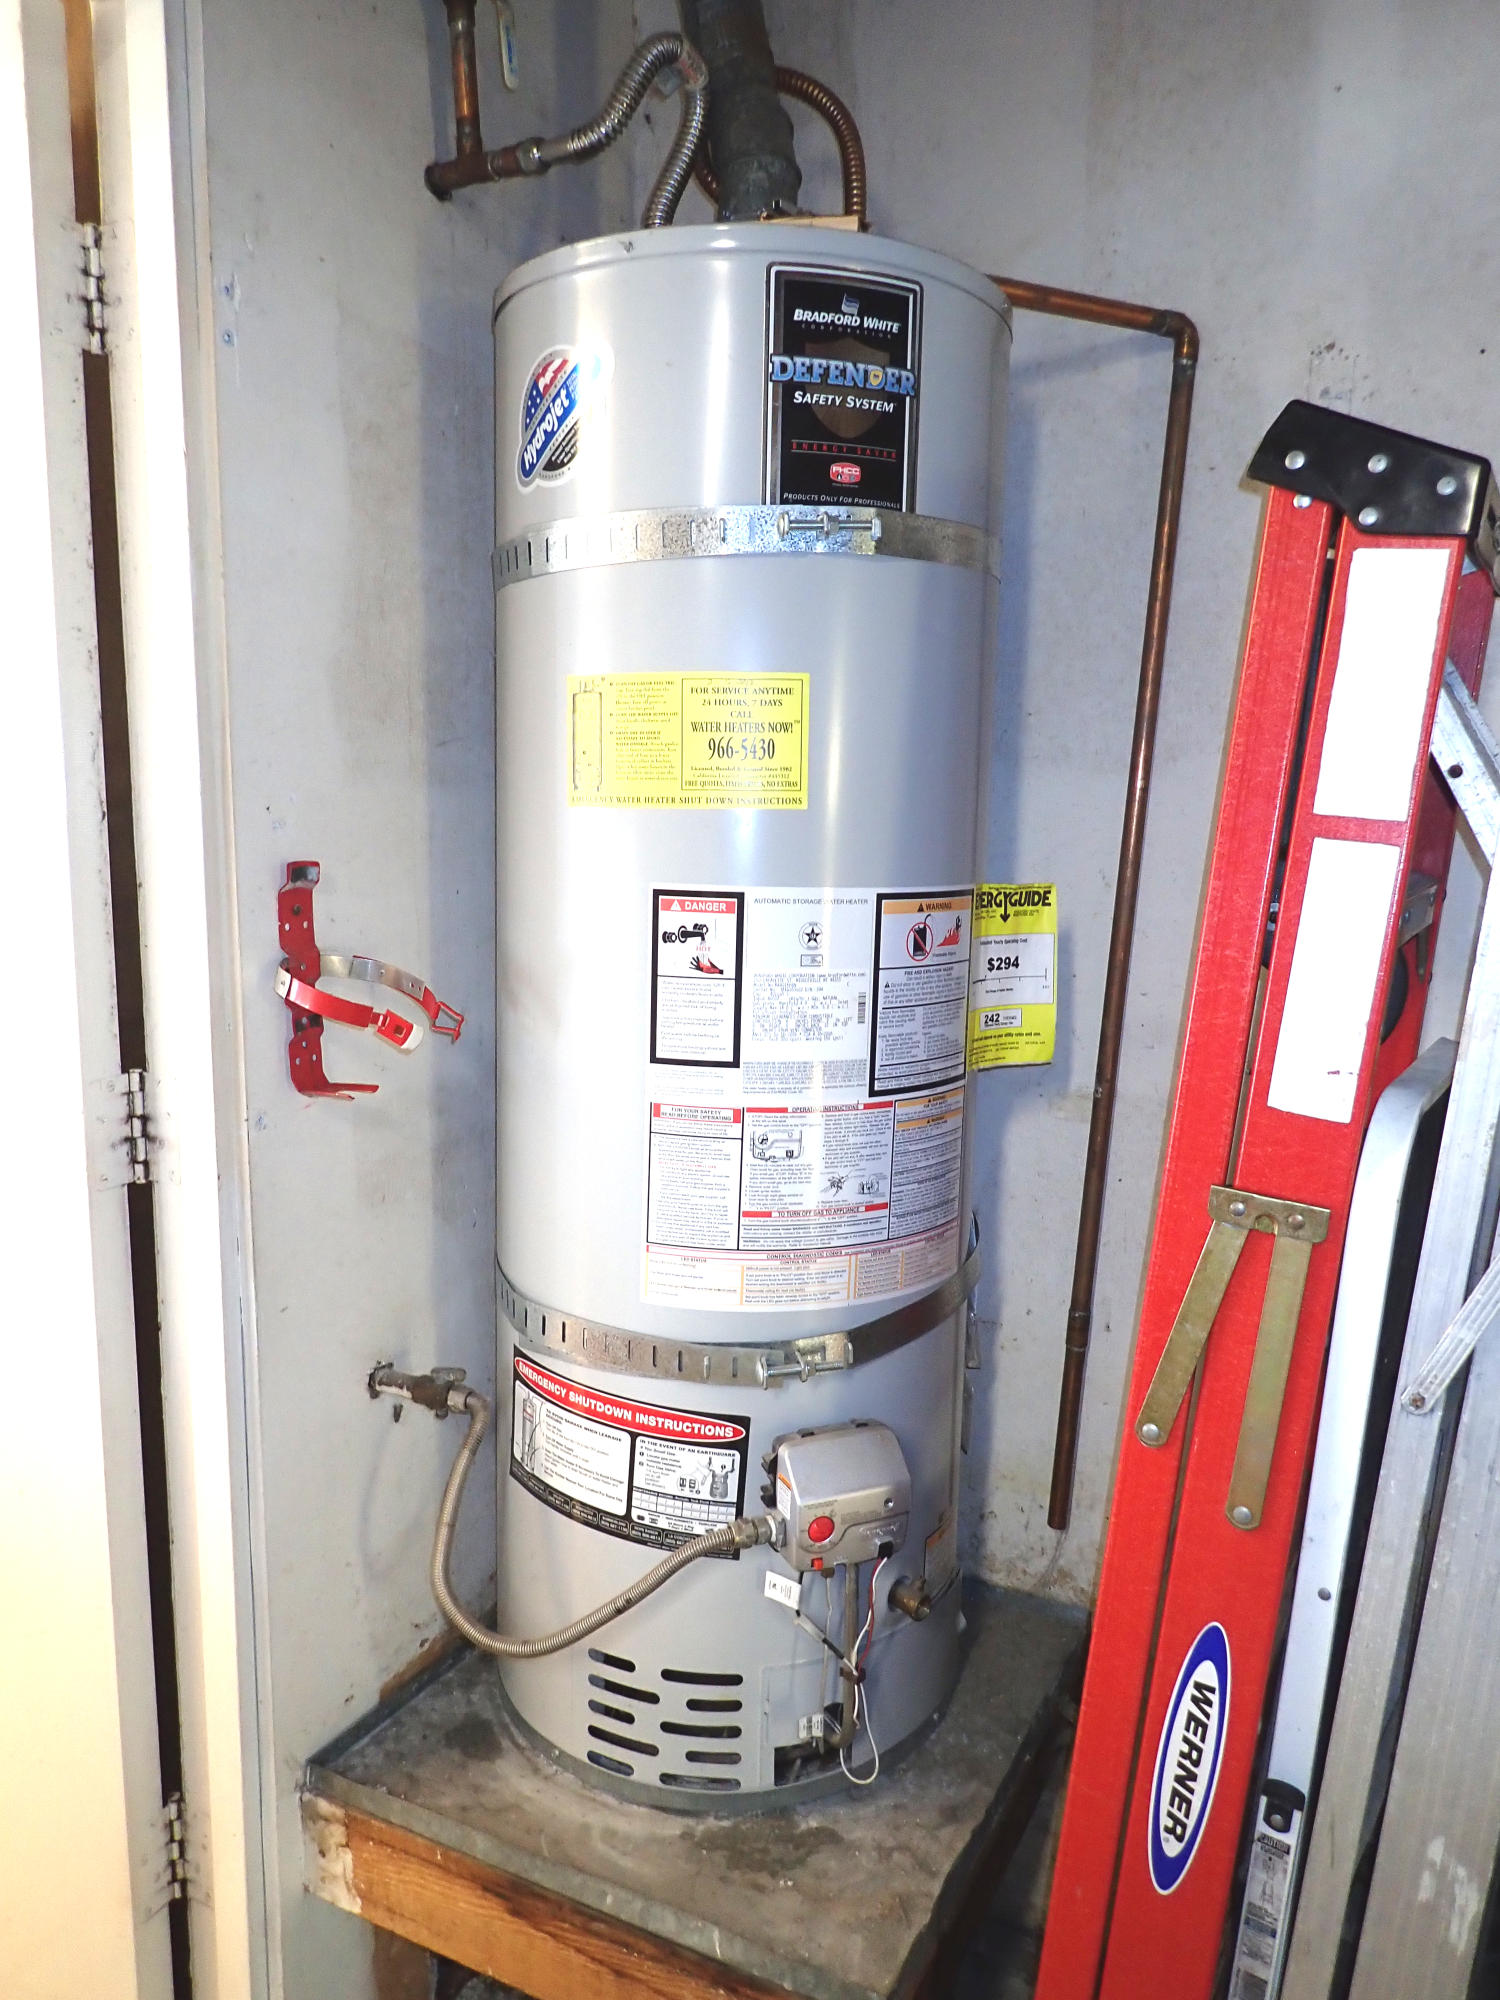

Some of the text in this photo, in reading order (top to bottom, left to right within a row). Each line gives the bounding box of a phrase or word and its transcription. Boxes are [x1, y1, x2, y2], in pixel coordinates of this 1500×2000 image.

[793, 308, 900, 334] BRADFORD WHITE
[771, 354, 915, 396] DEFENDER
[793, 390, 895, 414] SAFETY SYSTEM
[523, 385, 570, 470] Hydrojet
[832, 466, 860, 475] PHCC
[783, 492, 901, 509] PRODUCTS ONLY FOR PROFESSIONALS
[690, 687, 795, 695] FOR SERVICE ANYTIME
[714, 699, 749, 707] HOURS,
[760, 699, 783, 707] DAYS
[730, 710, 752, 718] CALL
[690, 721, 722, 733] WATER
[724, 722, 766, 734] HEATERS
[708, 736, 776, 760] 966-5430
[767, 780, 776, 788] NO
[644, 796, 676, 804] HEATER
[679, 796, 702, 804] SHUT
[705, 796, 734, 805] DOWN
[736, 796, 803, 805] INSTRUCTIONS
[684, 901, 727, 912] DANGER
[925, 902, 953, 911] WARNING
[987, 955, 1020, 973] $294
[984, 1013, 1000, 1024] 242
[823, 1104, 859, 1112] INSTRUCTIONS
[833, 1206, 860, 1214] APPLIANCE
[518, 1361, 735, 1439] EMERGENCY SHUTDOWN INSTRUCTIONS
[659, 1442, 678, 1451] EVENT
[696, 1449, 737, 1457] EARTHQUAKE
[1163, 1679, 1216, 1845] WERNER
